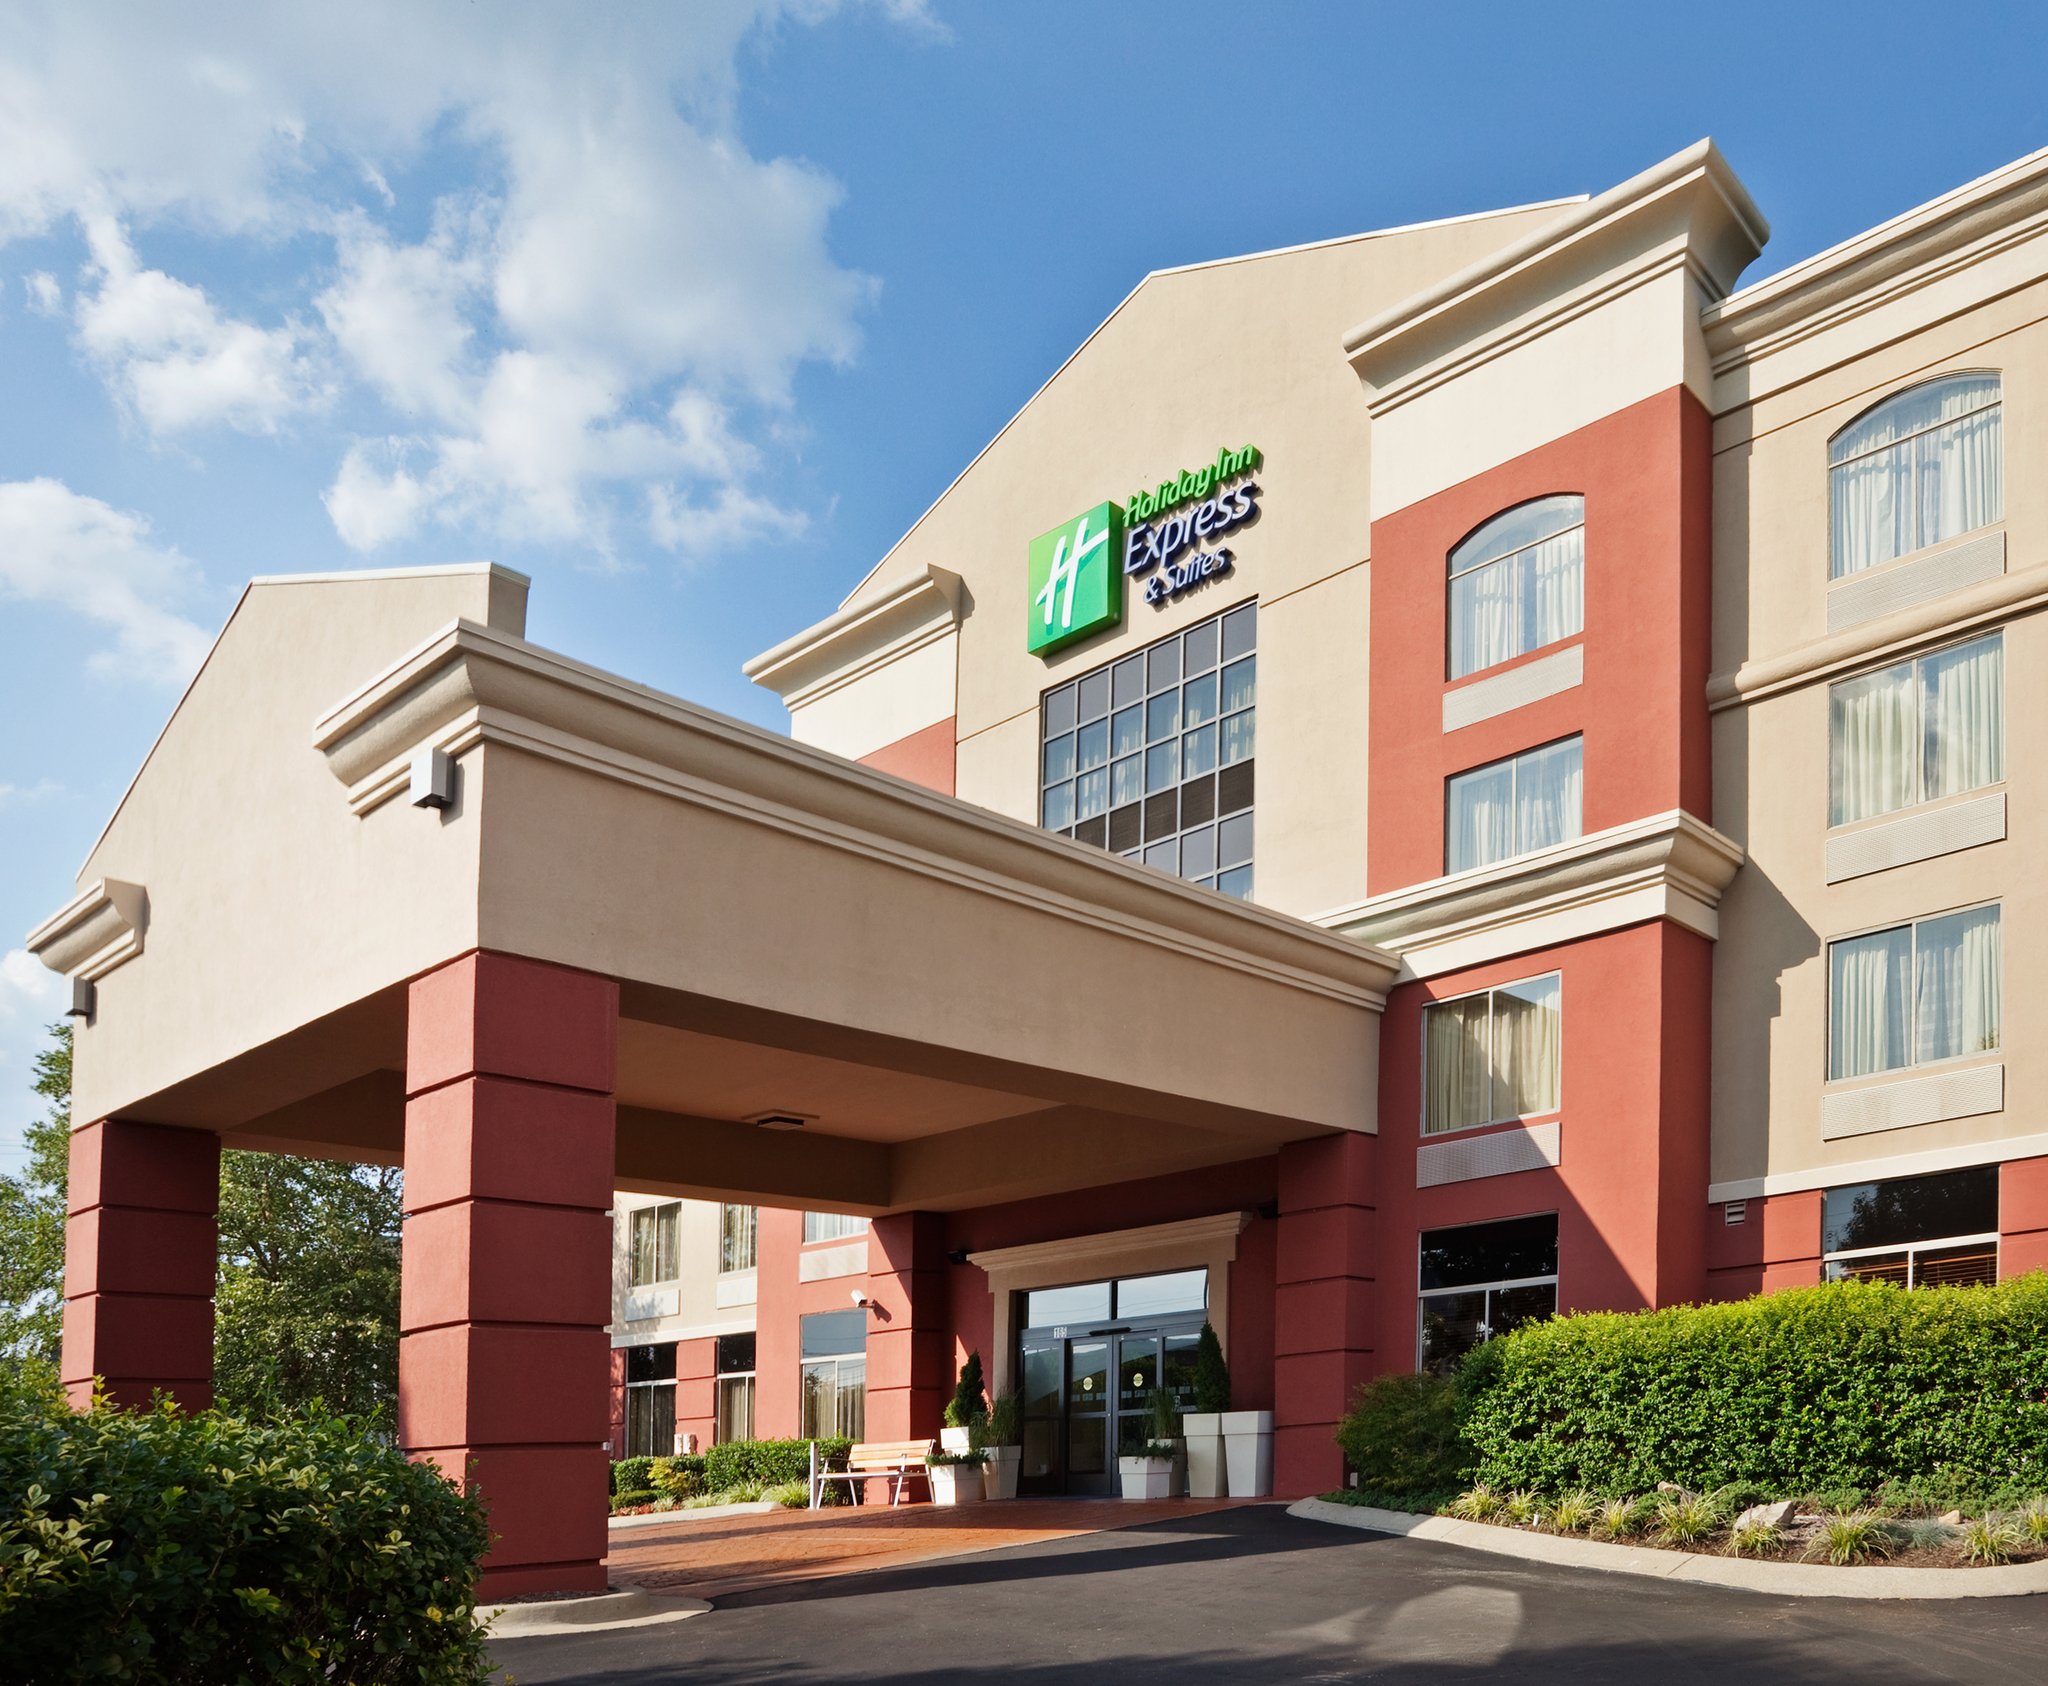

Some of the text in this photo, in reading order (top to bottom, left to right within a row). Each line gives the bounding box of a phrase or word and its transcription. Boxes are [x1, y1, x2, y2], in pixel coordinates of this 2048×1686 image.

[1122, 443, 1258, 528] Holiday Inn
[1123, 481, 1258, 576] Express
[1142, 547, 1228, 604] & Suites
